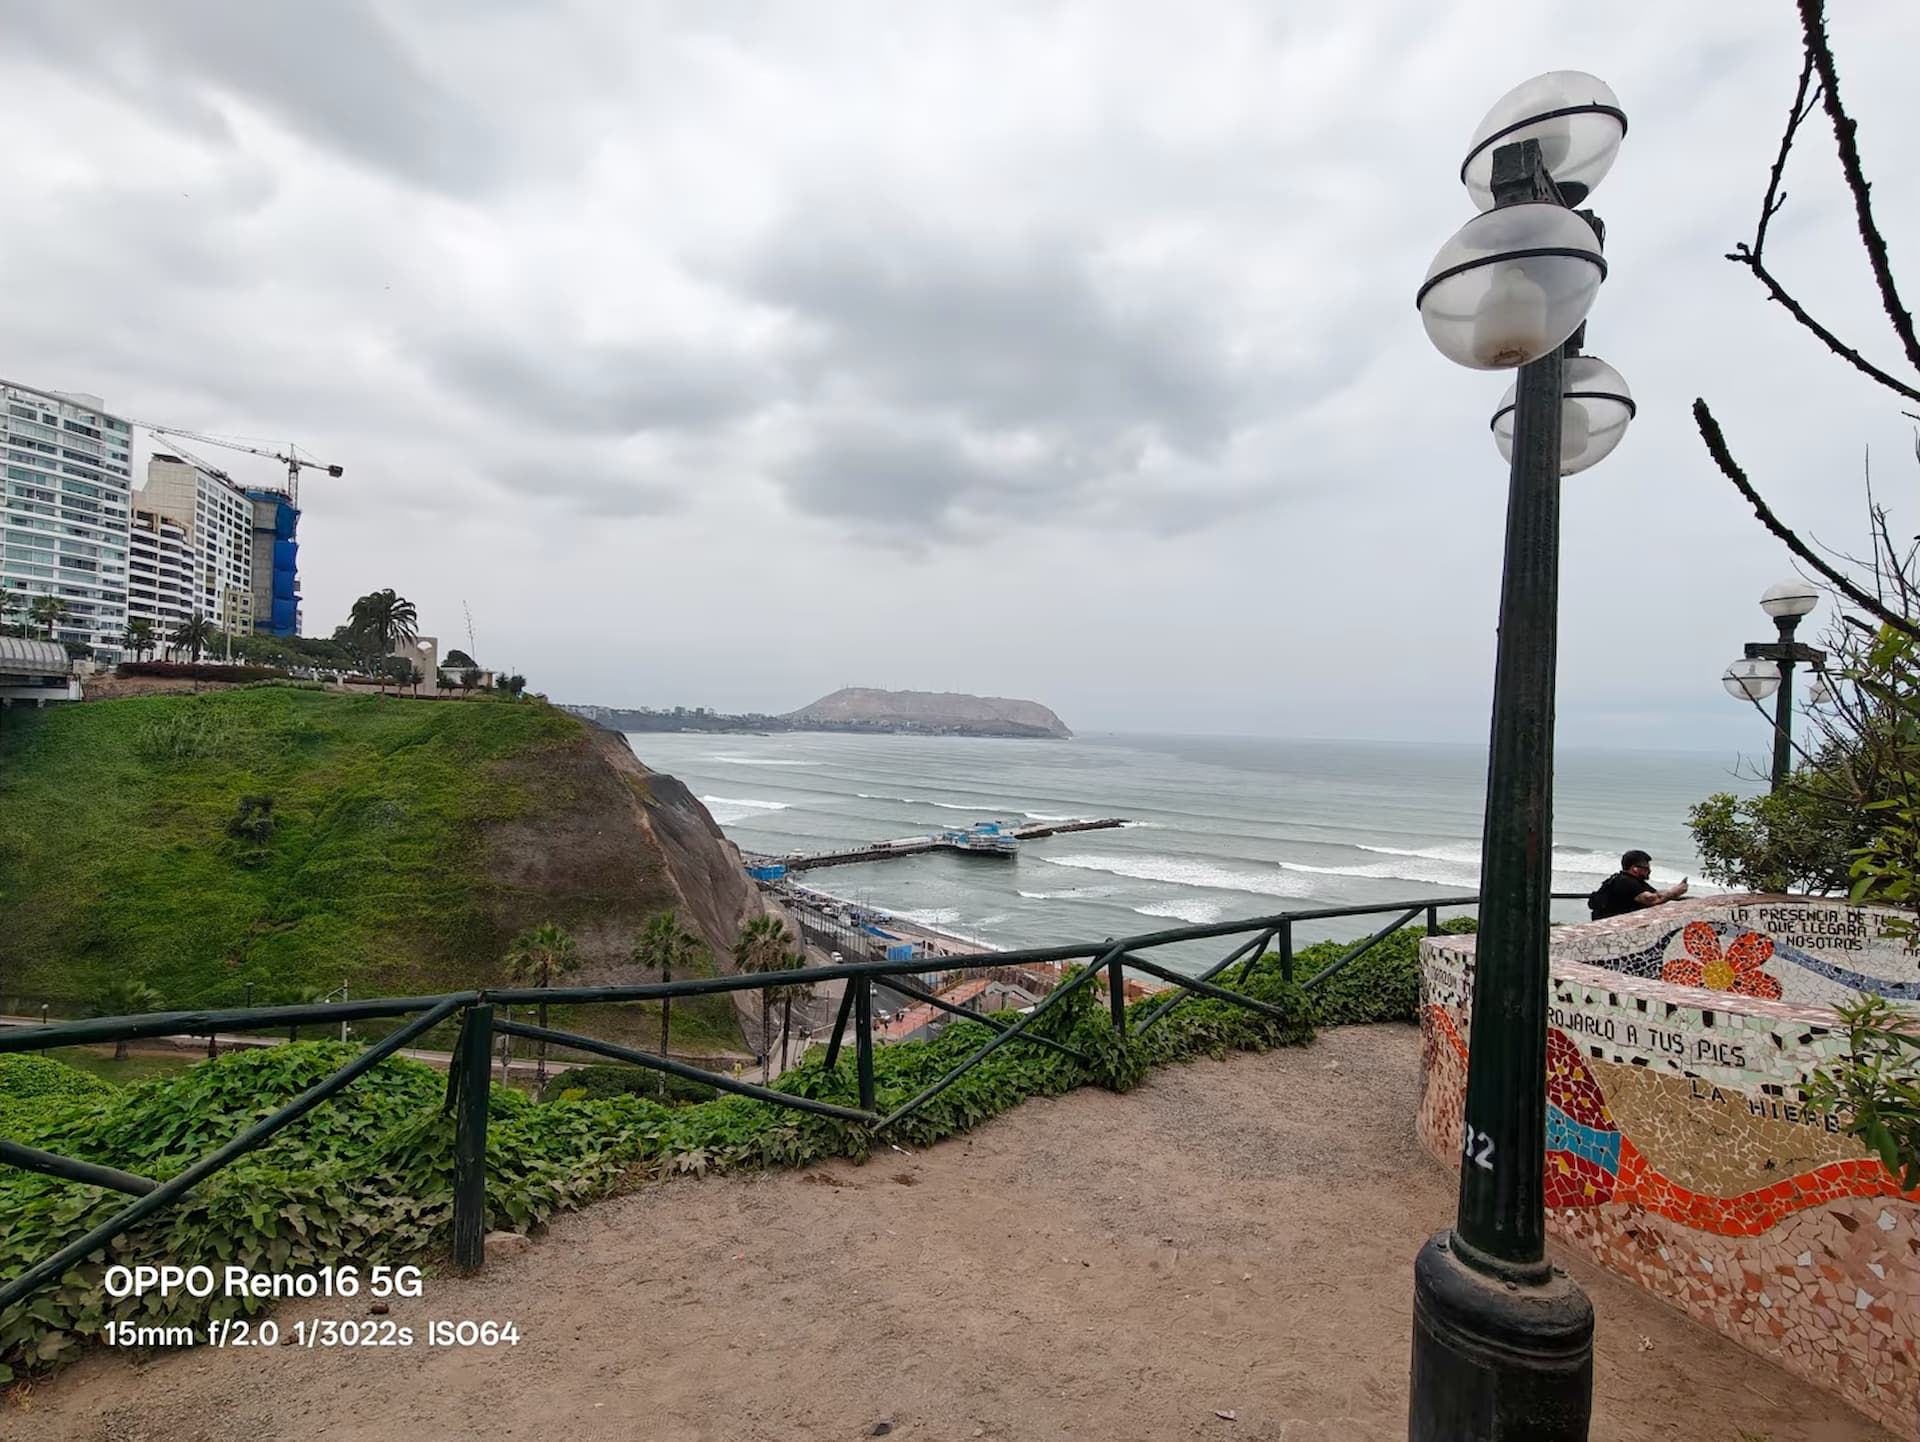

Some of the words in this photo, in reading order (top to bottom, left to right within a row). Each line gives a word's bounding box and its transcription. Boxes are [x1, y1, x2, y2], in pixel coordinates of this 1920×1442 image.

[1731, 909, 1749, 922] LA
[1759, 908, 1838, 923] PRESENCIA
[1847, 909, 1866, 926] DE
[1873, 913, 1900, 928] TU
[1768, 920, 1795, 934] QUE
[1802, 921, 1867, 938] LLEGARA
[1627, 1024, 1638, 1045] A
[1647, 1028, 1685, 1054] TUS
[1691, 1080, 1727, 1105] LA
[1748, 1099, 1853, 1139] HIERB
